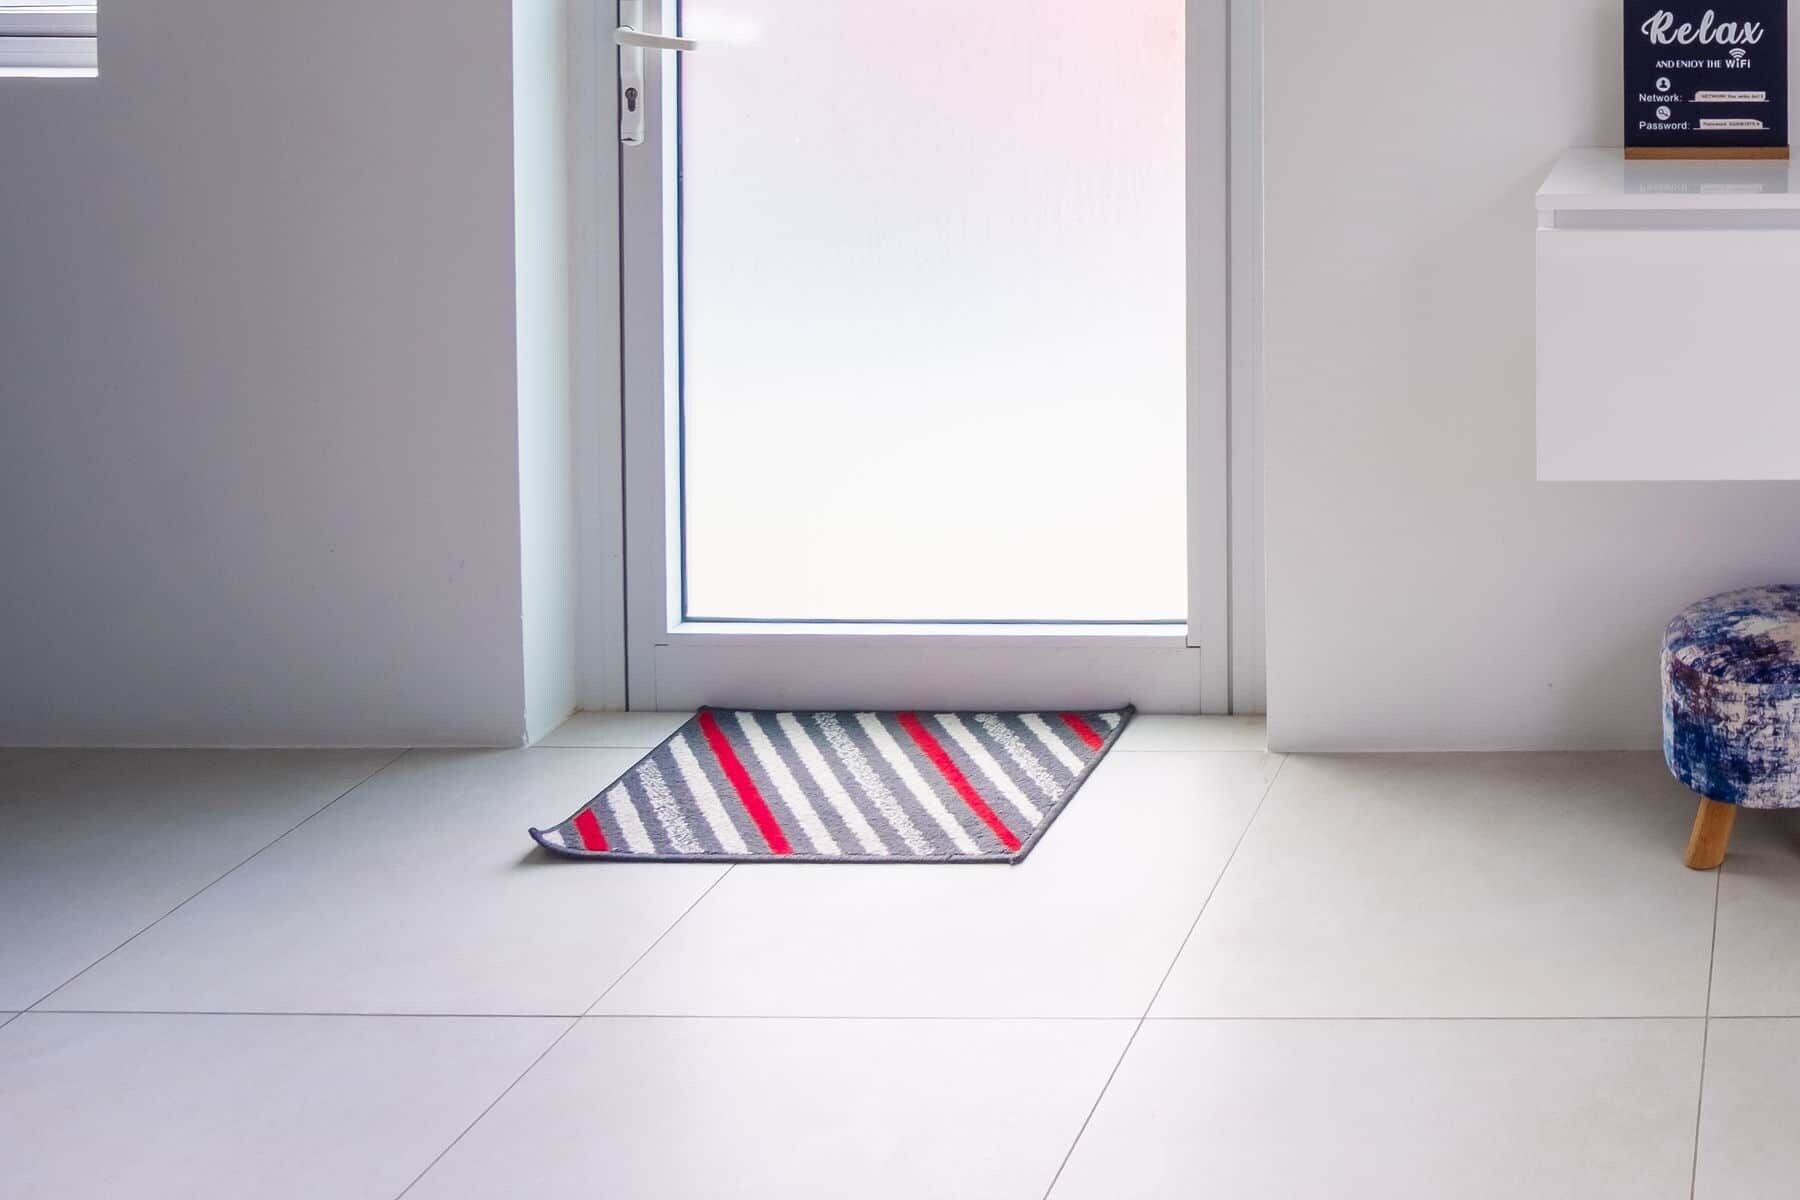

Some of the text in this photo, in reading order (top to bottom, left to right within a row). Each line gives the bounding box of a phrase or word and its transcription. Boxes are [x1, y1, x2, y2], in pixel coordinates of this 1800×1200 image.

[1641, 9, 1764, 45] Relax
[1655, 59, 1675, 69] AND
[1676, 59, 1703, 69] ENJOY
[1706, 59, 1721, 69] THE
[1639, 93, 1682, 103] Network:
[1639, 120, 1690, 130] Password:
